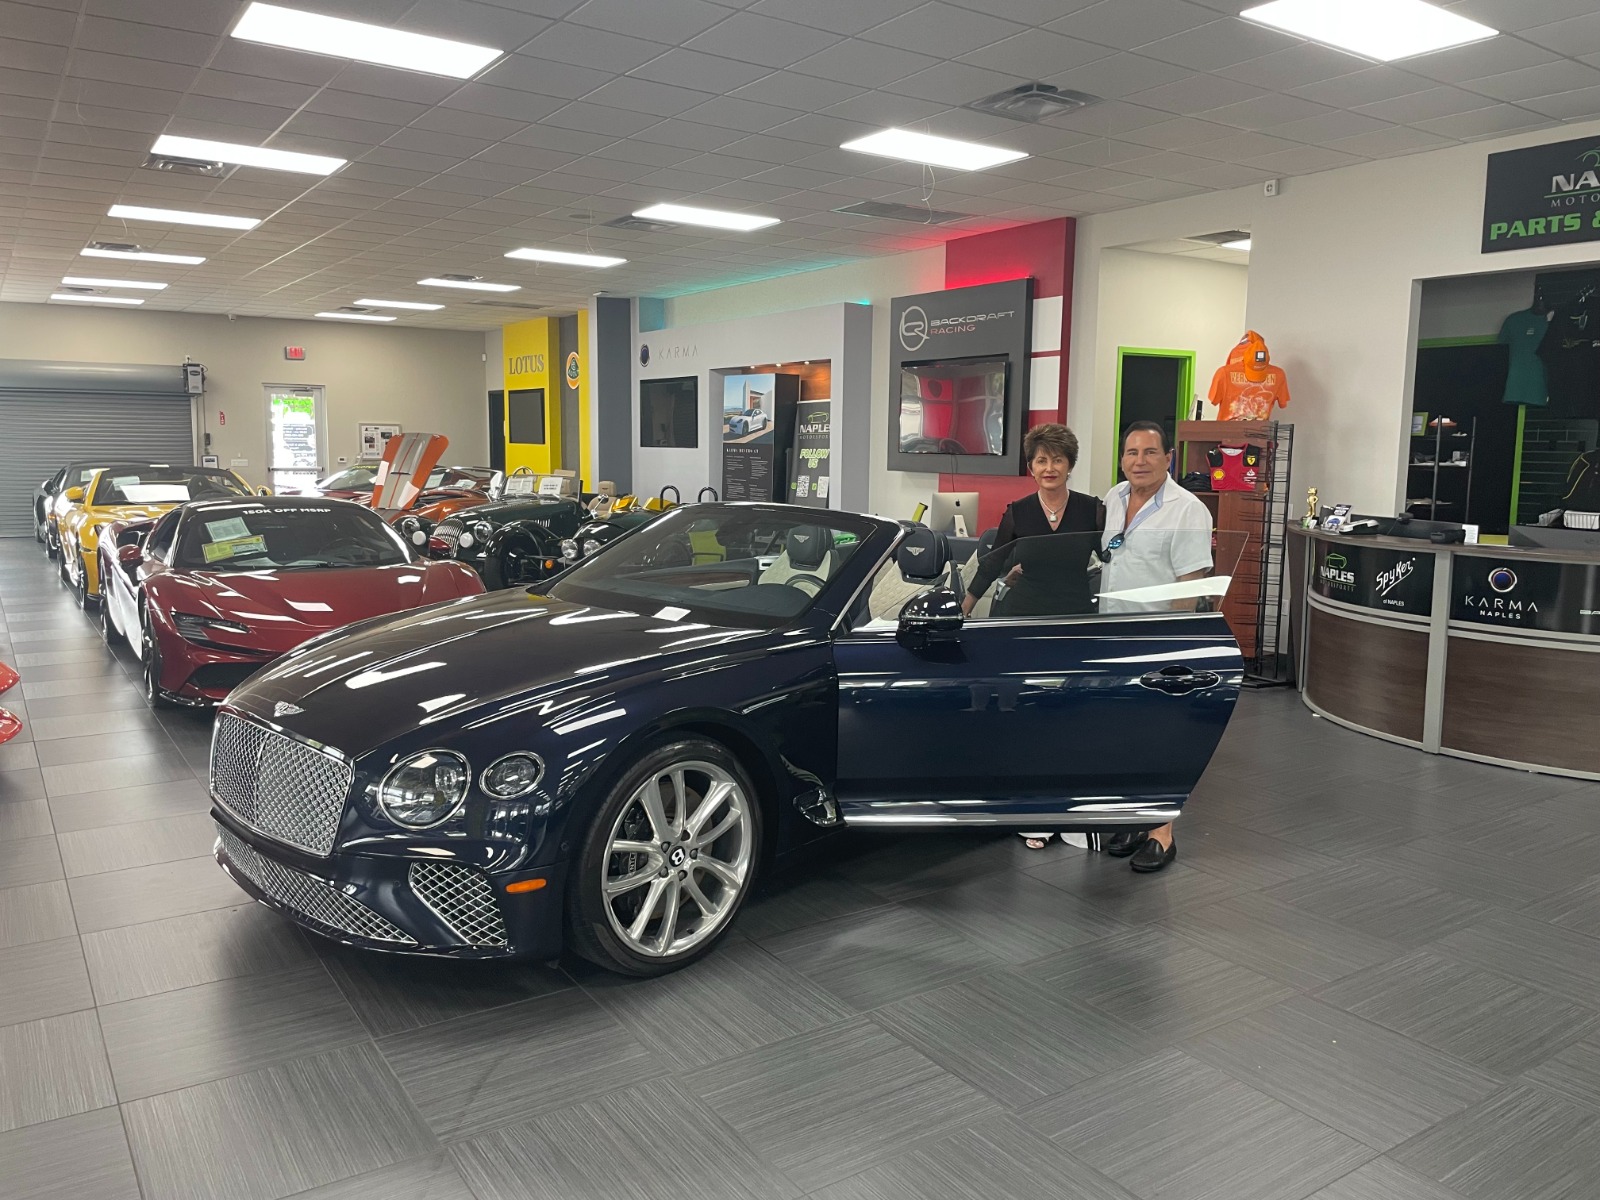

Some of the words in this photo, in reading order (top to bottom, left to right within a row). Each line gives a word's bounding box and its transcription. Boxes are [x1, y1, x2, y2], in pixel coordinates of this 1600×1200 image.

[1490, 212, 1581, 240] PARTS
[930, 311, 1015, 327] BACKDRAFT
[930, 324, 976, 335] RACING
[658, 344, 699, 360] KARMA
[508, 353, 545, 375] LOTUS
[799, 424, 830, 433] NAPLE
[799, 448, 830, 459] FOLLOW
[807, 459, 819, 469] US
[1320, 565, 1355, 583] NAPLES
[1465, 595, 1538, 612] KARMA
[1480, 610, 1521, 620] NAPLES
